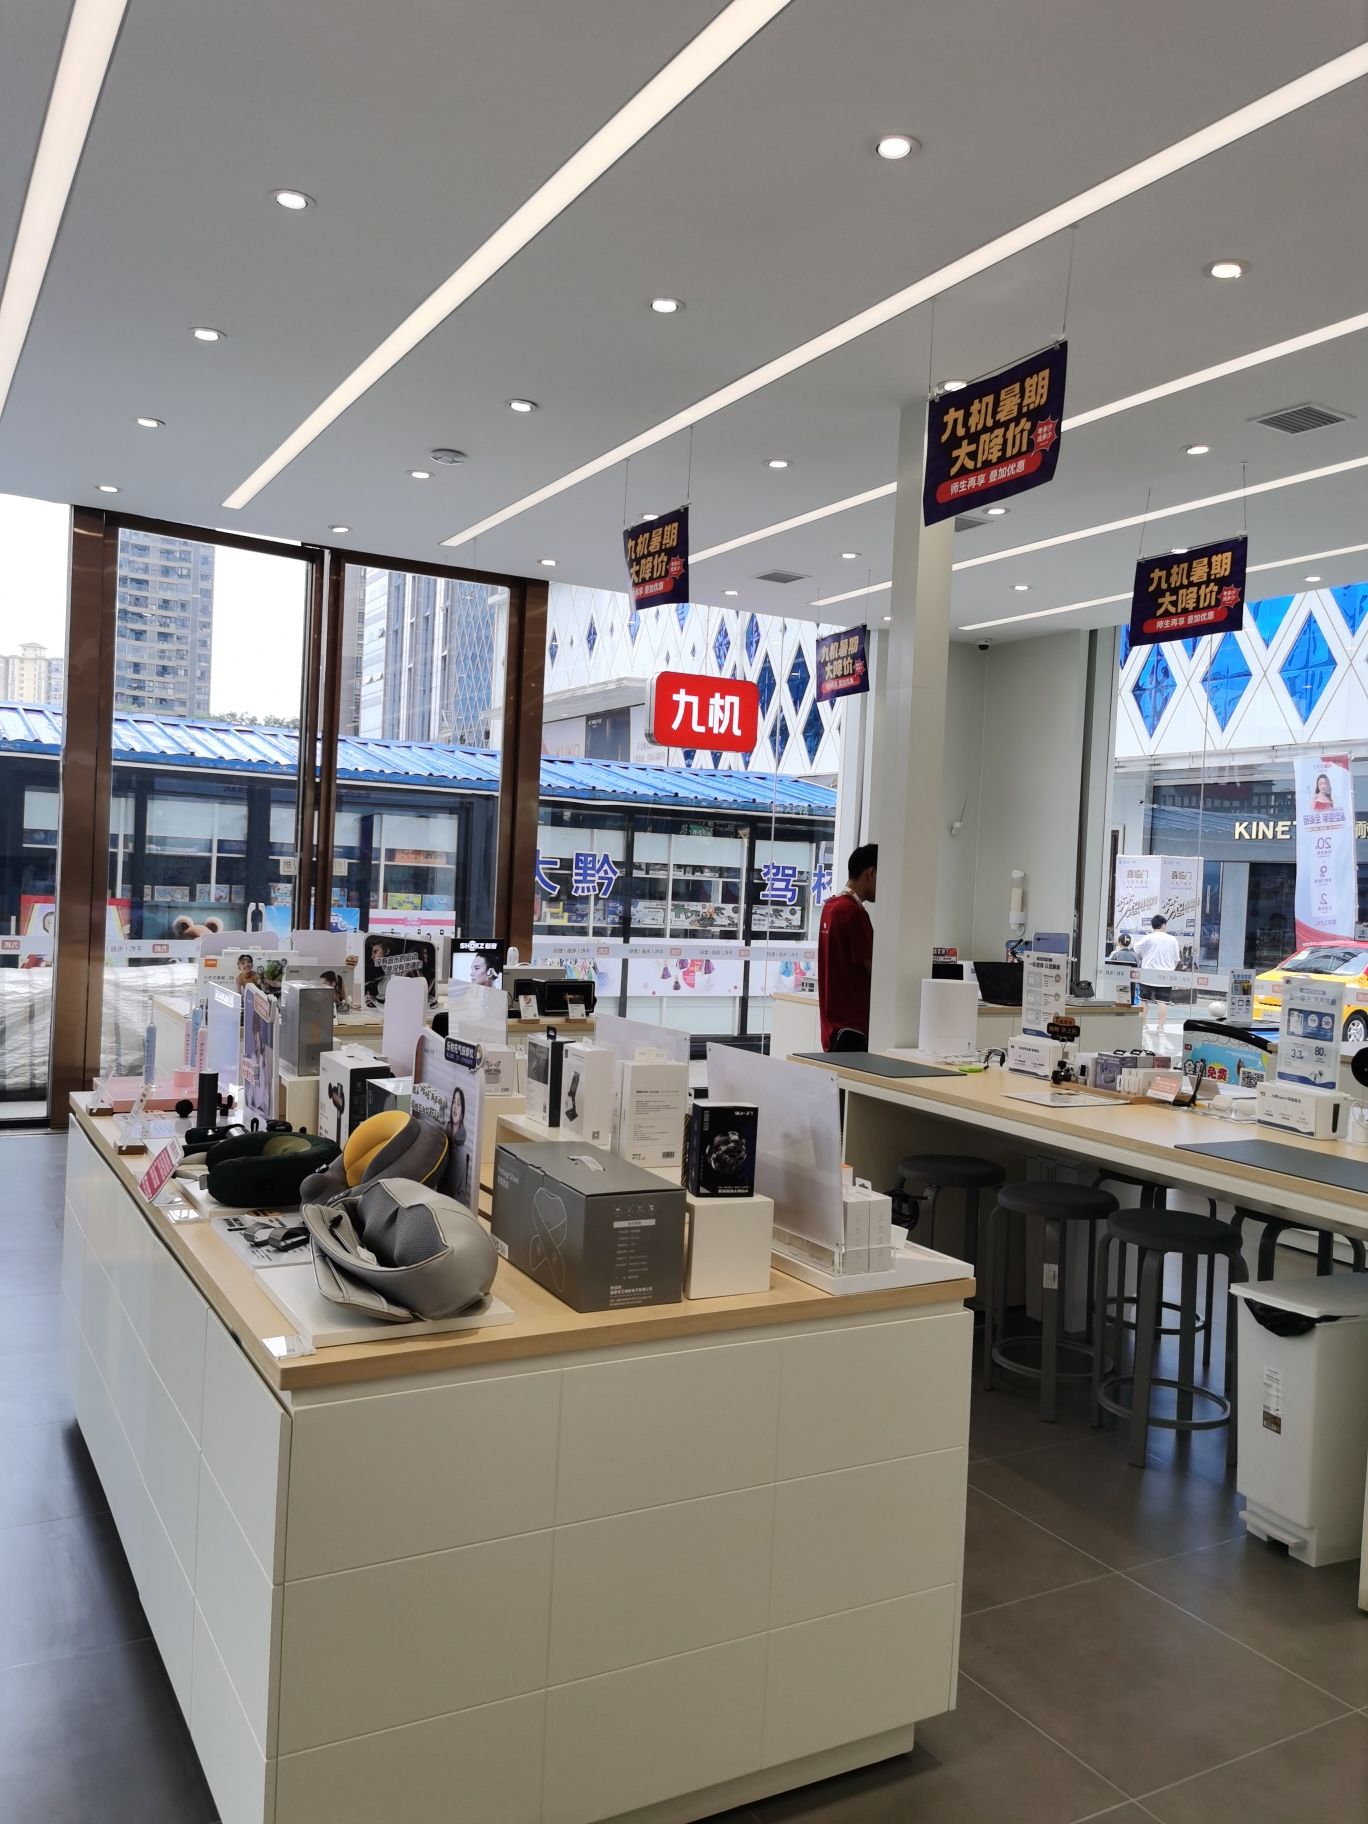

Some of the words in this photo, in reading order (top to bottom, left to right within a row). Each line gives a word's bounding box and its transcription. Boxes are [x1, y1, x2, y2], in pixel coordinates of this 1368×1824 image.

[940, 368, 1050, 444] 九机暑期
[949, 418, 1032, 477] 大降价
[950, 473, 986, 496] 师生再享
[988, 459, 1026, 483] 叠加优惠
[627, 522, 679, 561] 九机暑期
[629, 552, 668, 584] 大降价
[1147, 551, 1232, 592] 九机暑期
[1156, 582, 1219, 617] 大降价
[820, 635, 859, 663] 九机暑期
[671, 688, 742, 737] 九机
[1234, 820, 1296, 841] KINE
[459, 940, 485, 951] SHOKZ
